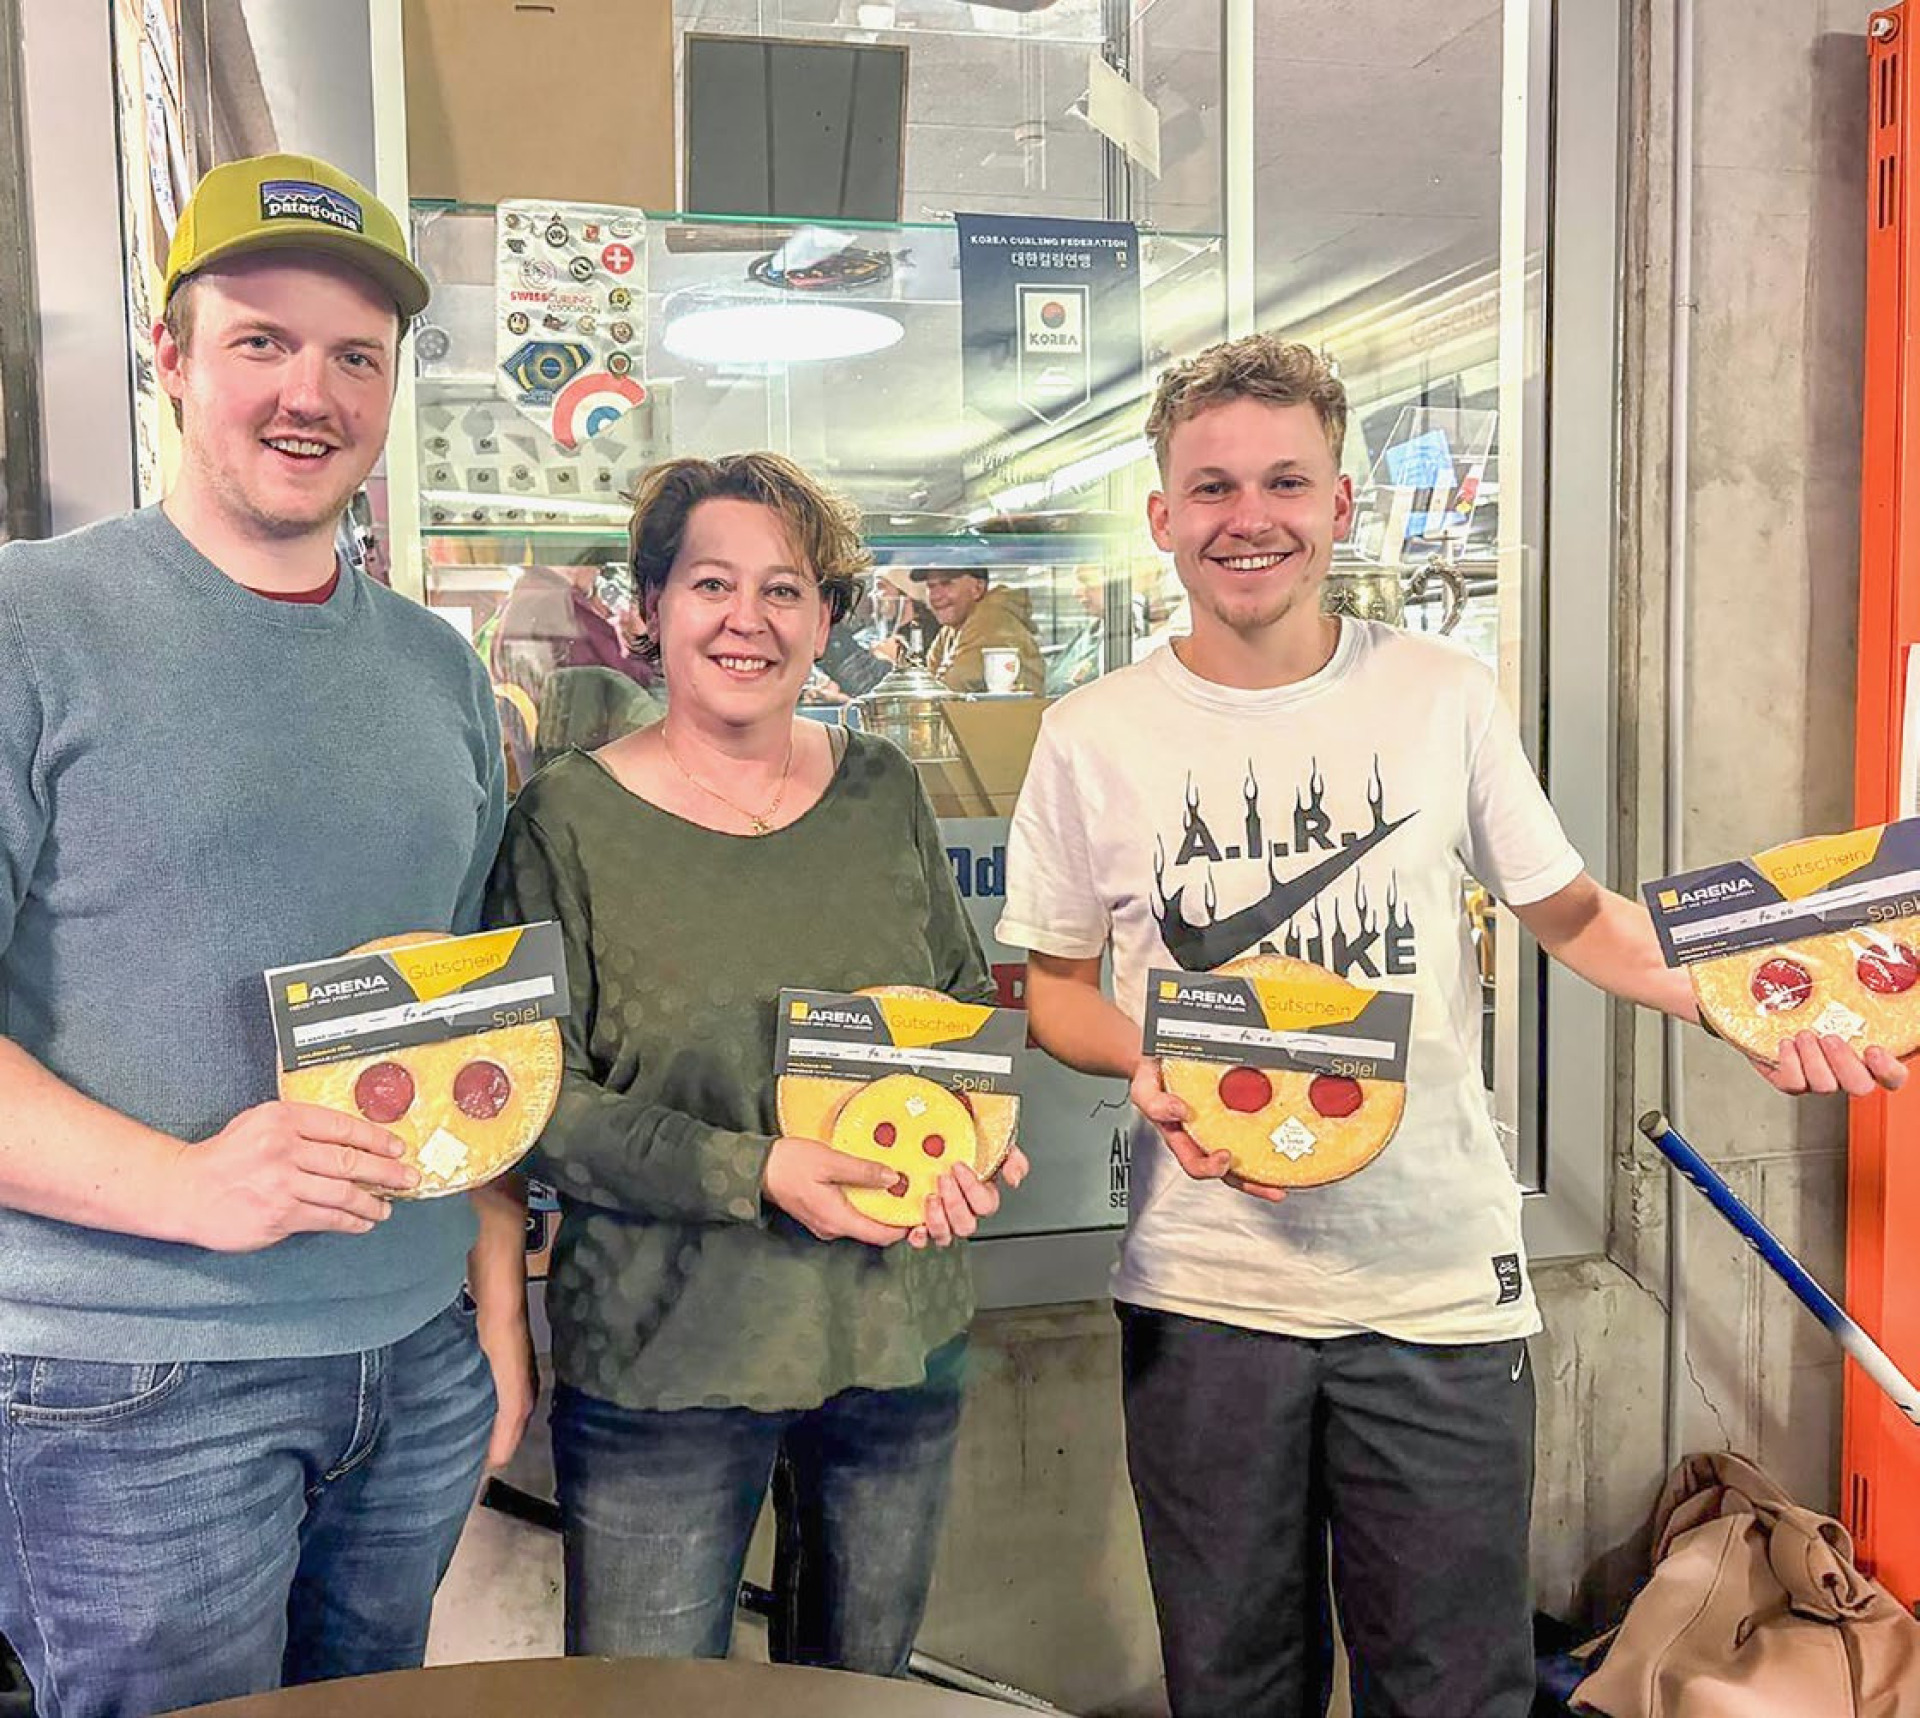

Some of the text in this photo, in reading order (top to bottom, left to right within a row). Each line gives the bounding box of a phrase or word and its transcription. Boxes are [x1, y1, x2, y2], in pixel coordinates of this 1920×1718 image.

[268, 203, 358, 230] patagonia
[970, 235, 1128, 248] KOREA CURLING FEDERATION
[1029, 333, 1078, 346] KOREA
[1175, 782, 1357, 866] A.I.R.
[1770, 850, 1868, 881] Gutschein
[1681, 877, 1753, 904] ARENA
[1867, 895, 1920, 921] Spiel
[407, 952, 501, 980] Gutschein
[310, 975, 388, 999] ARENA
[1178, 988, 1246, 1006] ARENA
[492, 1002, 541, 1028] Spiel
[808, 1009, 874, 1025] ARENA
[1264, 995, 1351, 1017] Gutschein
[890, 1014, 971, 1033] Gutschein
[1331, 1060, 1378, 1078] Spiel
[952, 1072, 996, 1092] Spiel
[1109, 1192, 1128, 1208] SE
